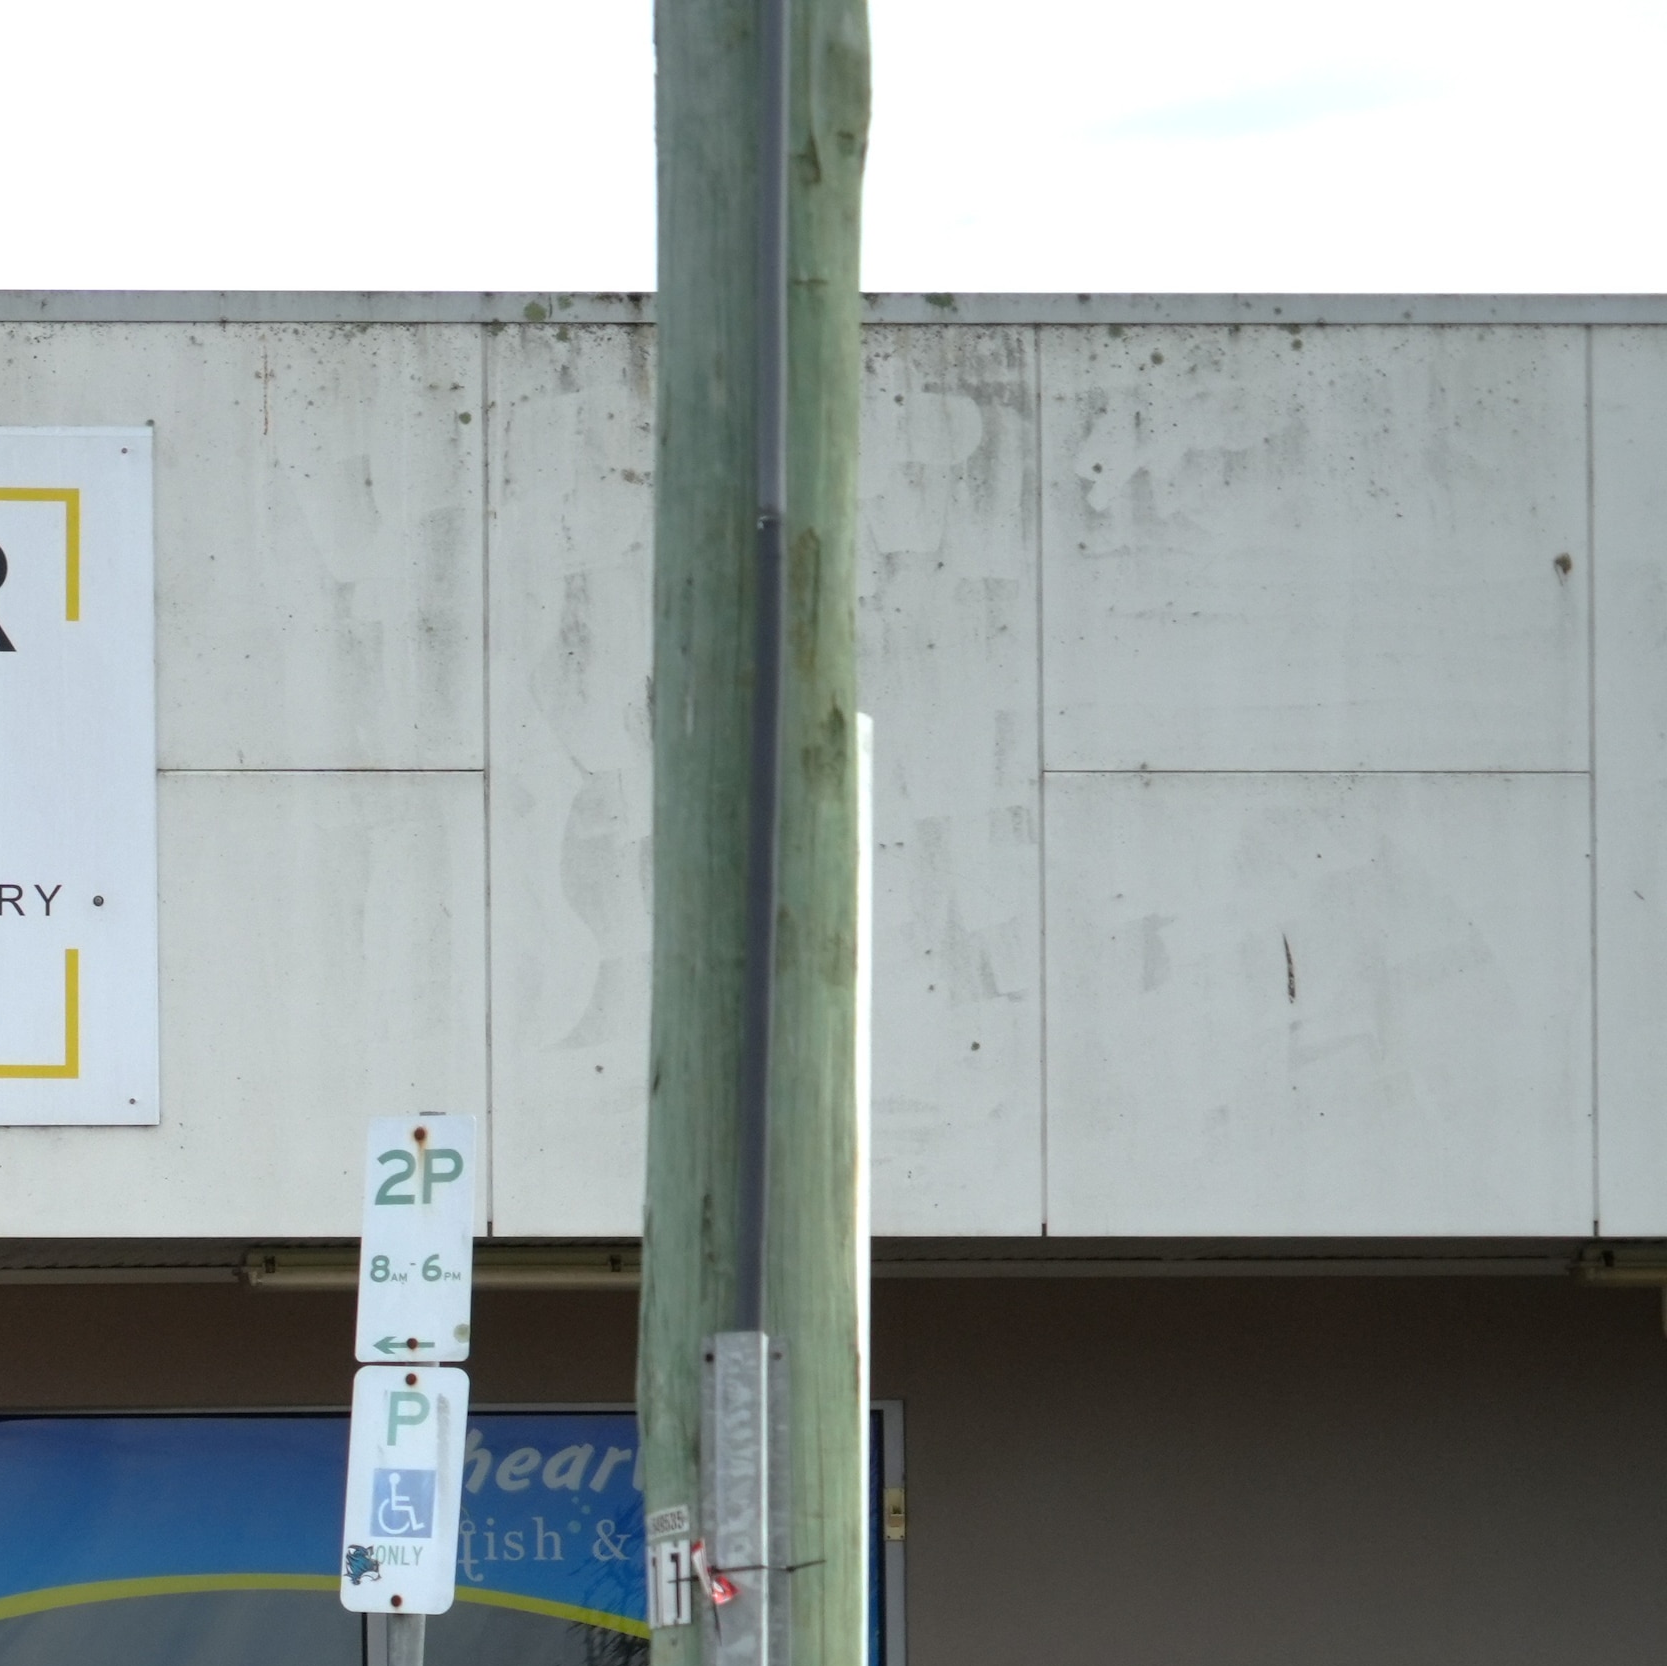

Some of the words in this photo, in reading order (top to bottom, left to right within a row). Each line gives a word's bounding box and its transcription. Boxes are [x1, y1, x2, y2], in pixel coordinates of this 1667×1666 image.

[374, 1148, 464, 1206] 2P
[386, 1391, 430, 1446] P
[374, 1544, 425, 1567] ONLY
[591, 1518, 632, 1562] &
